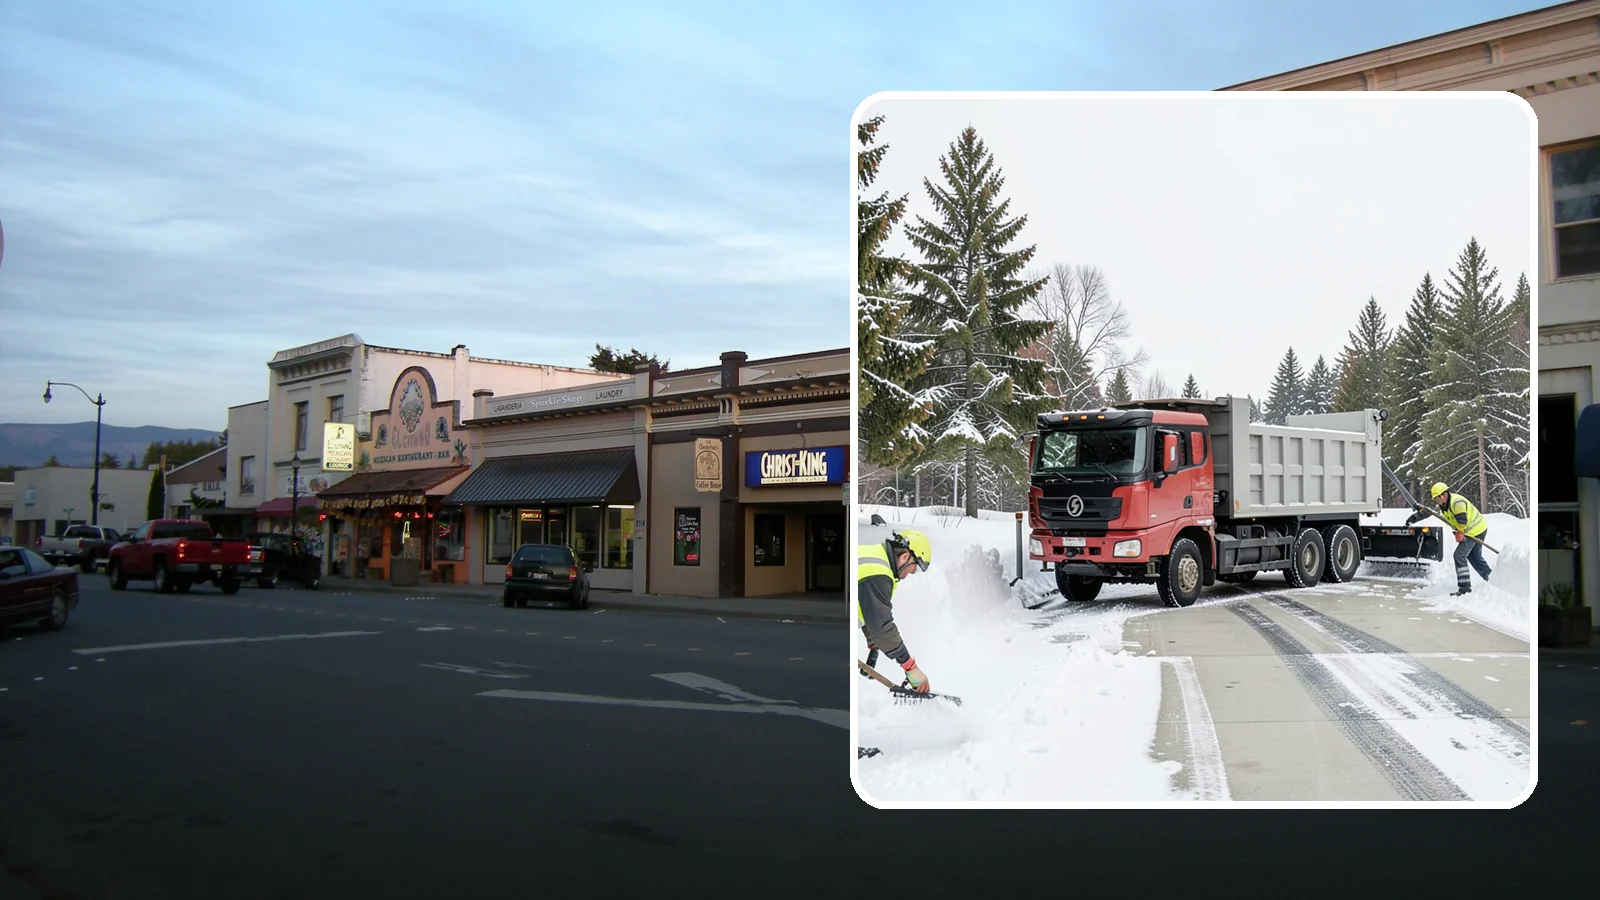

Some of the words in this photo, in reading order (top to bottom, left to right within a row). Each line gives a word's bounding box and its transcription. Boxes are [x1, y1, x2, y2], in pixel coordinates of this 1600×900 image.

[494, 402, 523, 412] LAVANDERIA
[562, 395, 582, 405] Shop
[596, 389, 623, 400] LAUNDRY
[373, 455, 396, 464] MEXICAN
[398, 452, 433, 462] RESTAURANT
[438, 450, 450, 458] BAR
[761, 452, 797, 478] CHRIST
[799, 450, 826, 476] KING
